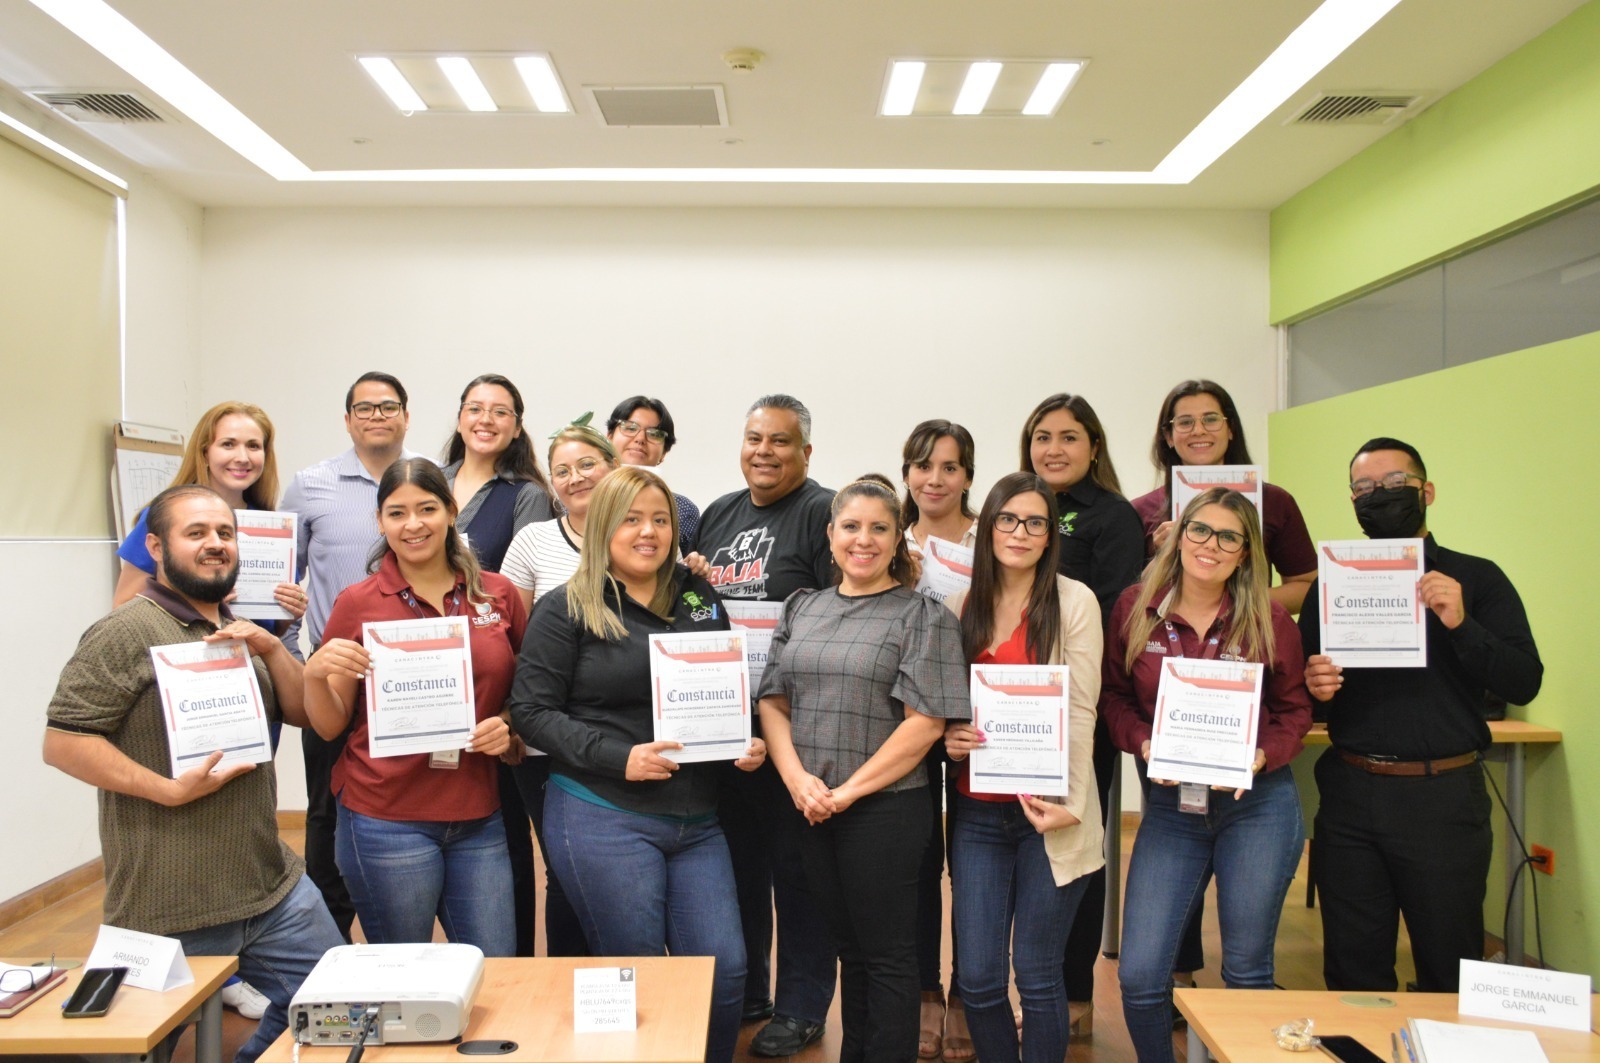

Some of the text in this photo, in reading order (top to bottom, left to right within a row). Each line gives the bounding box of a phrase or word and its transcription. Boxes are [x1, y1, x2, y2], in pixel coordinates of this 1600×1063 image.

[238, 558, 285, 570] onstancia
[709, 558, 763, 586] BAJA
[743, 583, 764, 595] TEAM
[1334, 595, 1408, 609] Constancia
[382, 675, 457, 693] Constancia
[179, 692, 248, 713] Constancia
[667, 687, 736, 703] Constancia
[1169, 708, 1241, 728] Constancia
[984, 720, 1053, 734] Constancia
[112, 951, 150, 966] ARMANDO
[1471, 982, 1579, 1006] JORGE EMMANUEL
[1502, 999, 1546, 1014] GARCIA
